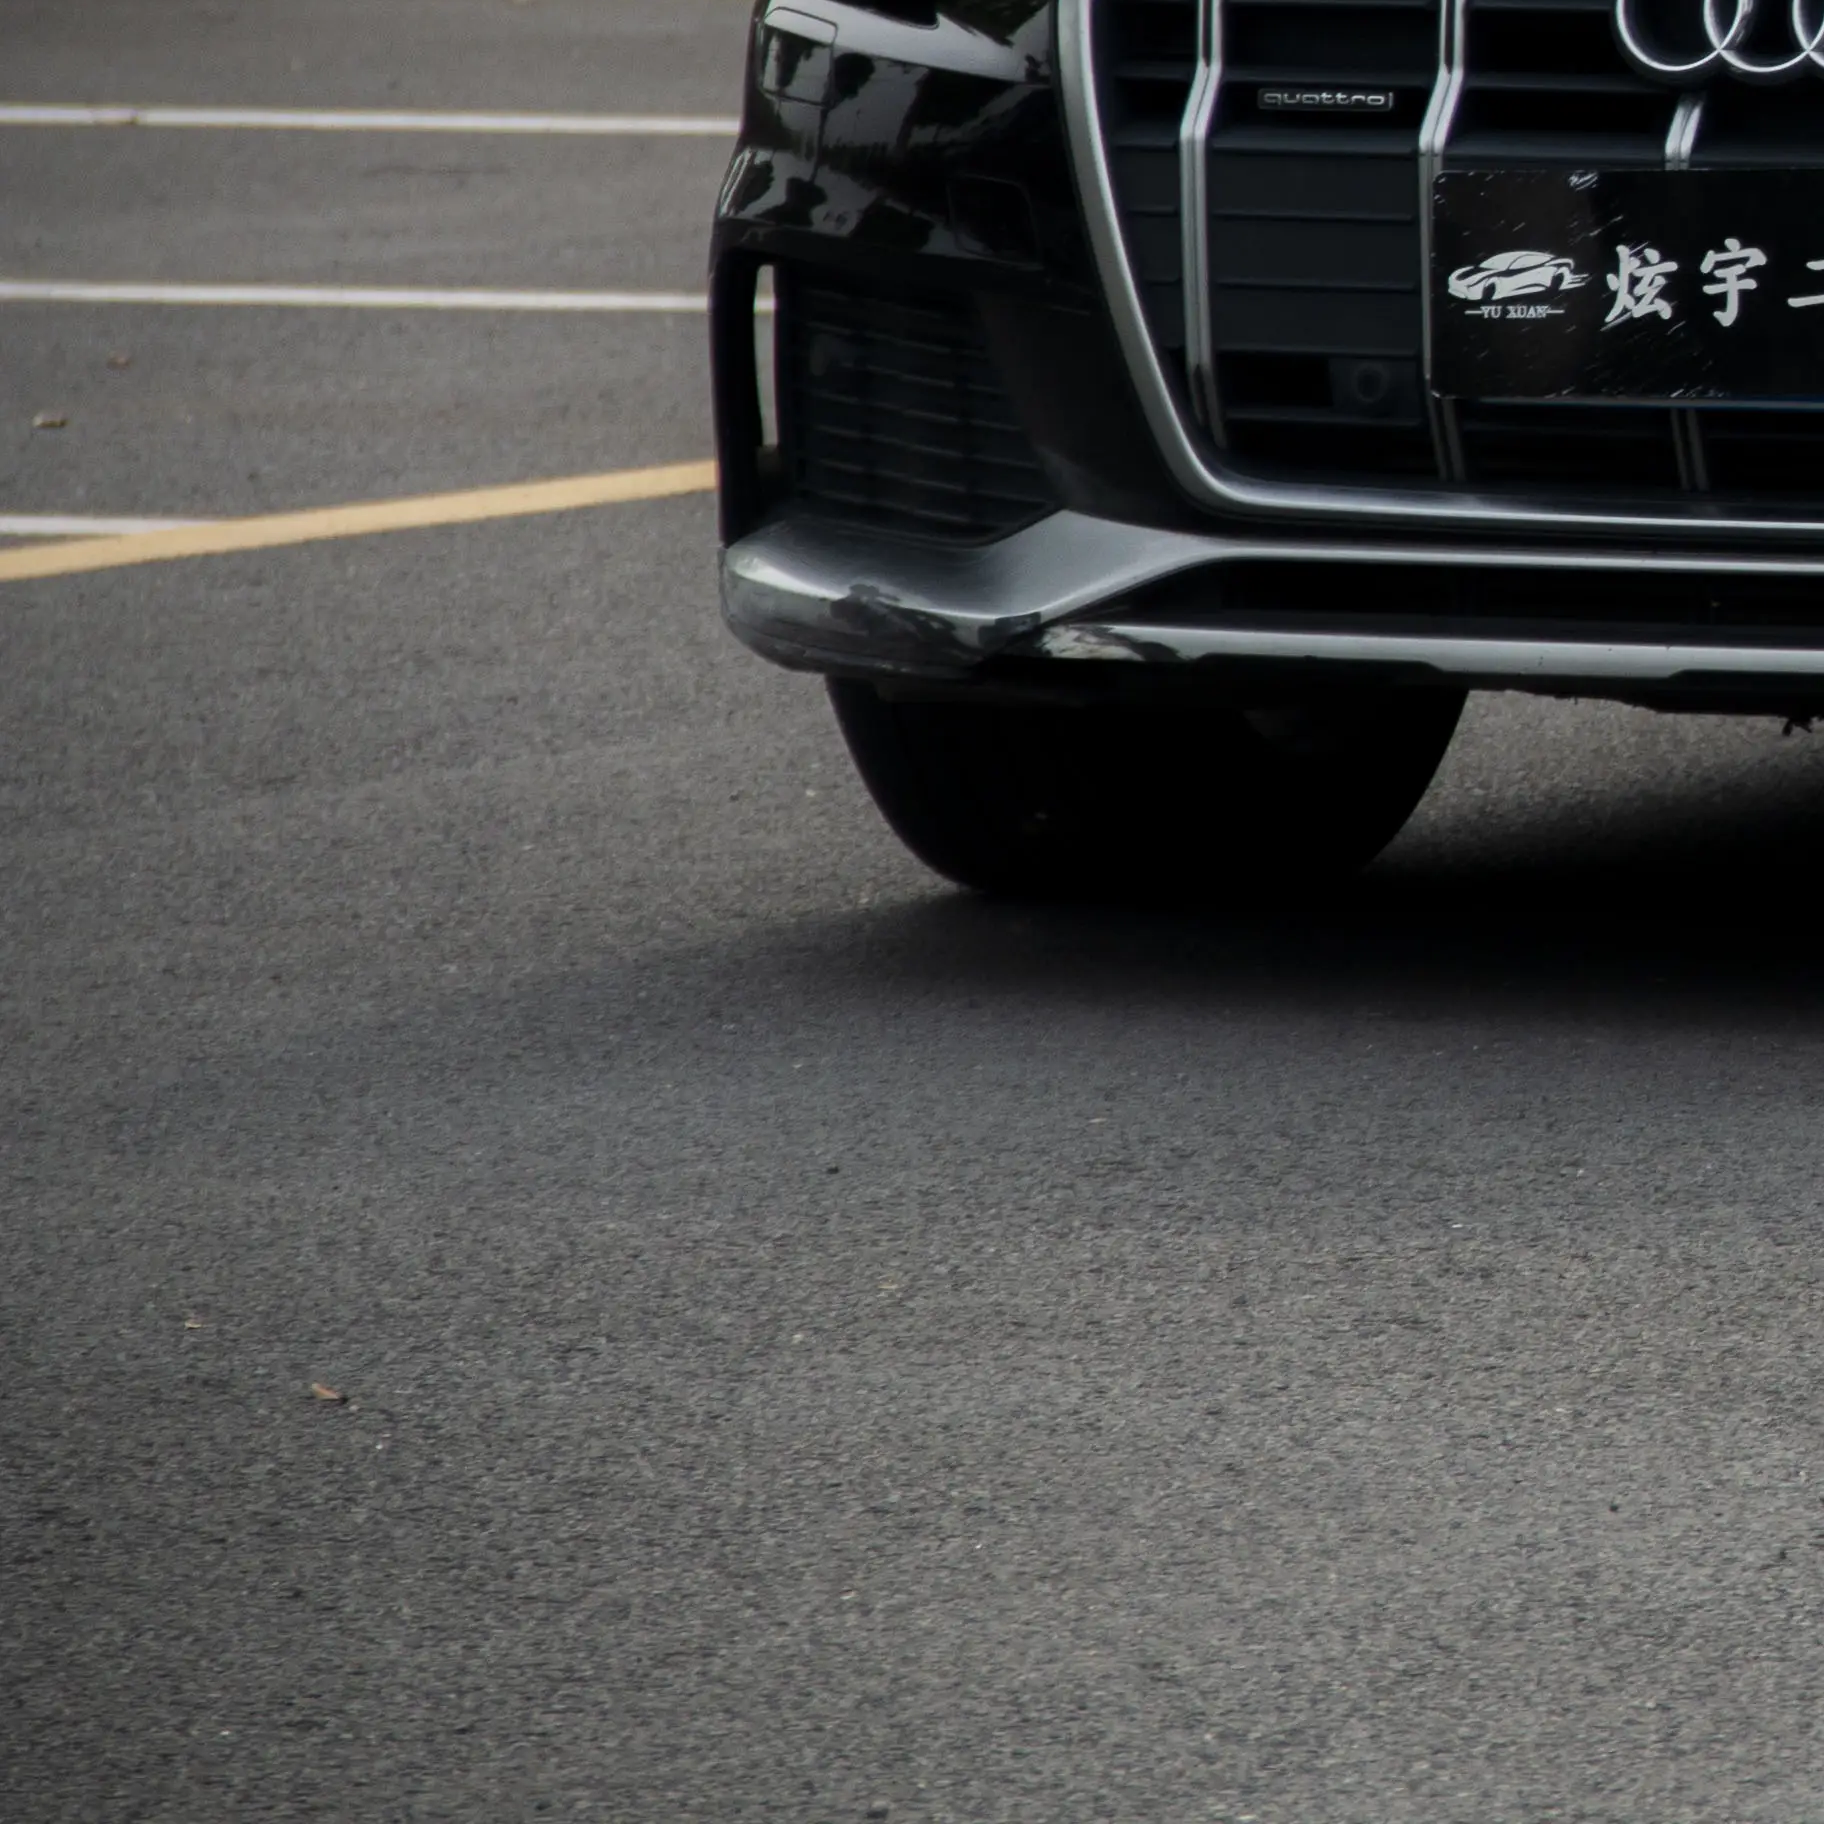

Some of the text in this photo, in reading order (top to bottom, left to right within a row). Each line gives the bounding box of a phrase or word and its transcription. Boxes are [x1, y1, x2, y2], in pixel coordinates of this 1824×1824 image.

[1263, 91, 1386, 107] quattro
[1480, 305, 1549, 319] YU XUAN
